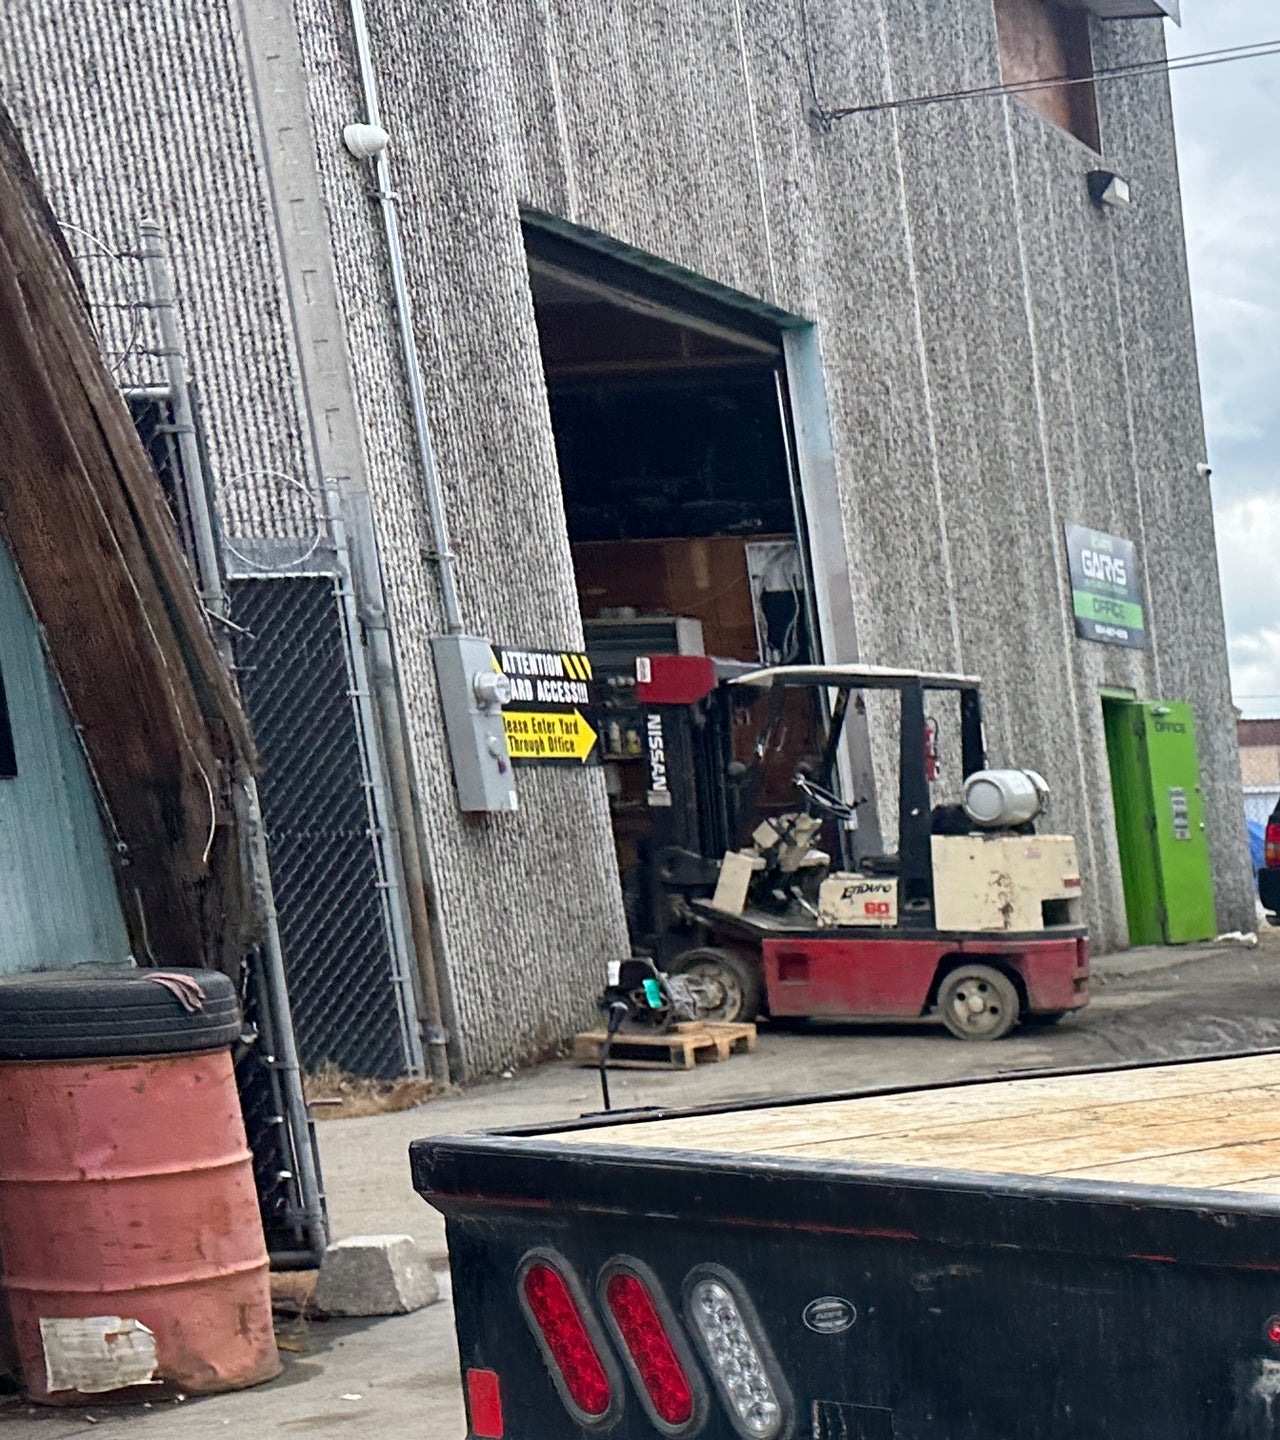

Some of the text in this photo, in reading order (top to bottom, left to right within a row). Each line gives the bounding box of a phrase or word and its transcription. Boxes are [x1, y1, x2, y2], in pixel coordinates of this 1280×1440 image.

[501, 651, 564, 677] ATTENTION
[510, 678, 533, 701] ARD
[503, 716, 579, 735] lease Enter Yard
[508, 735, 575, 755] Through Office
[647, 714, 667, 790] NISSAN
